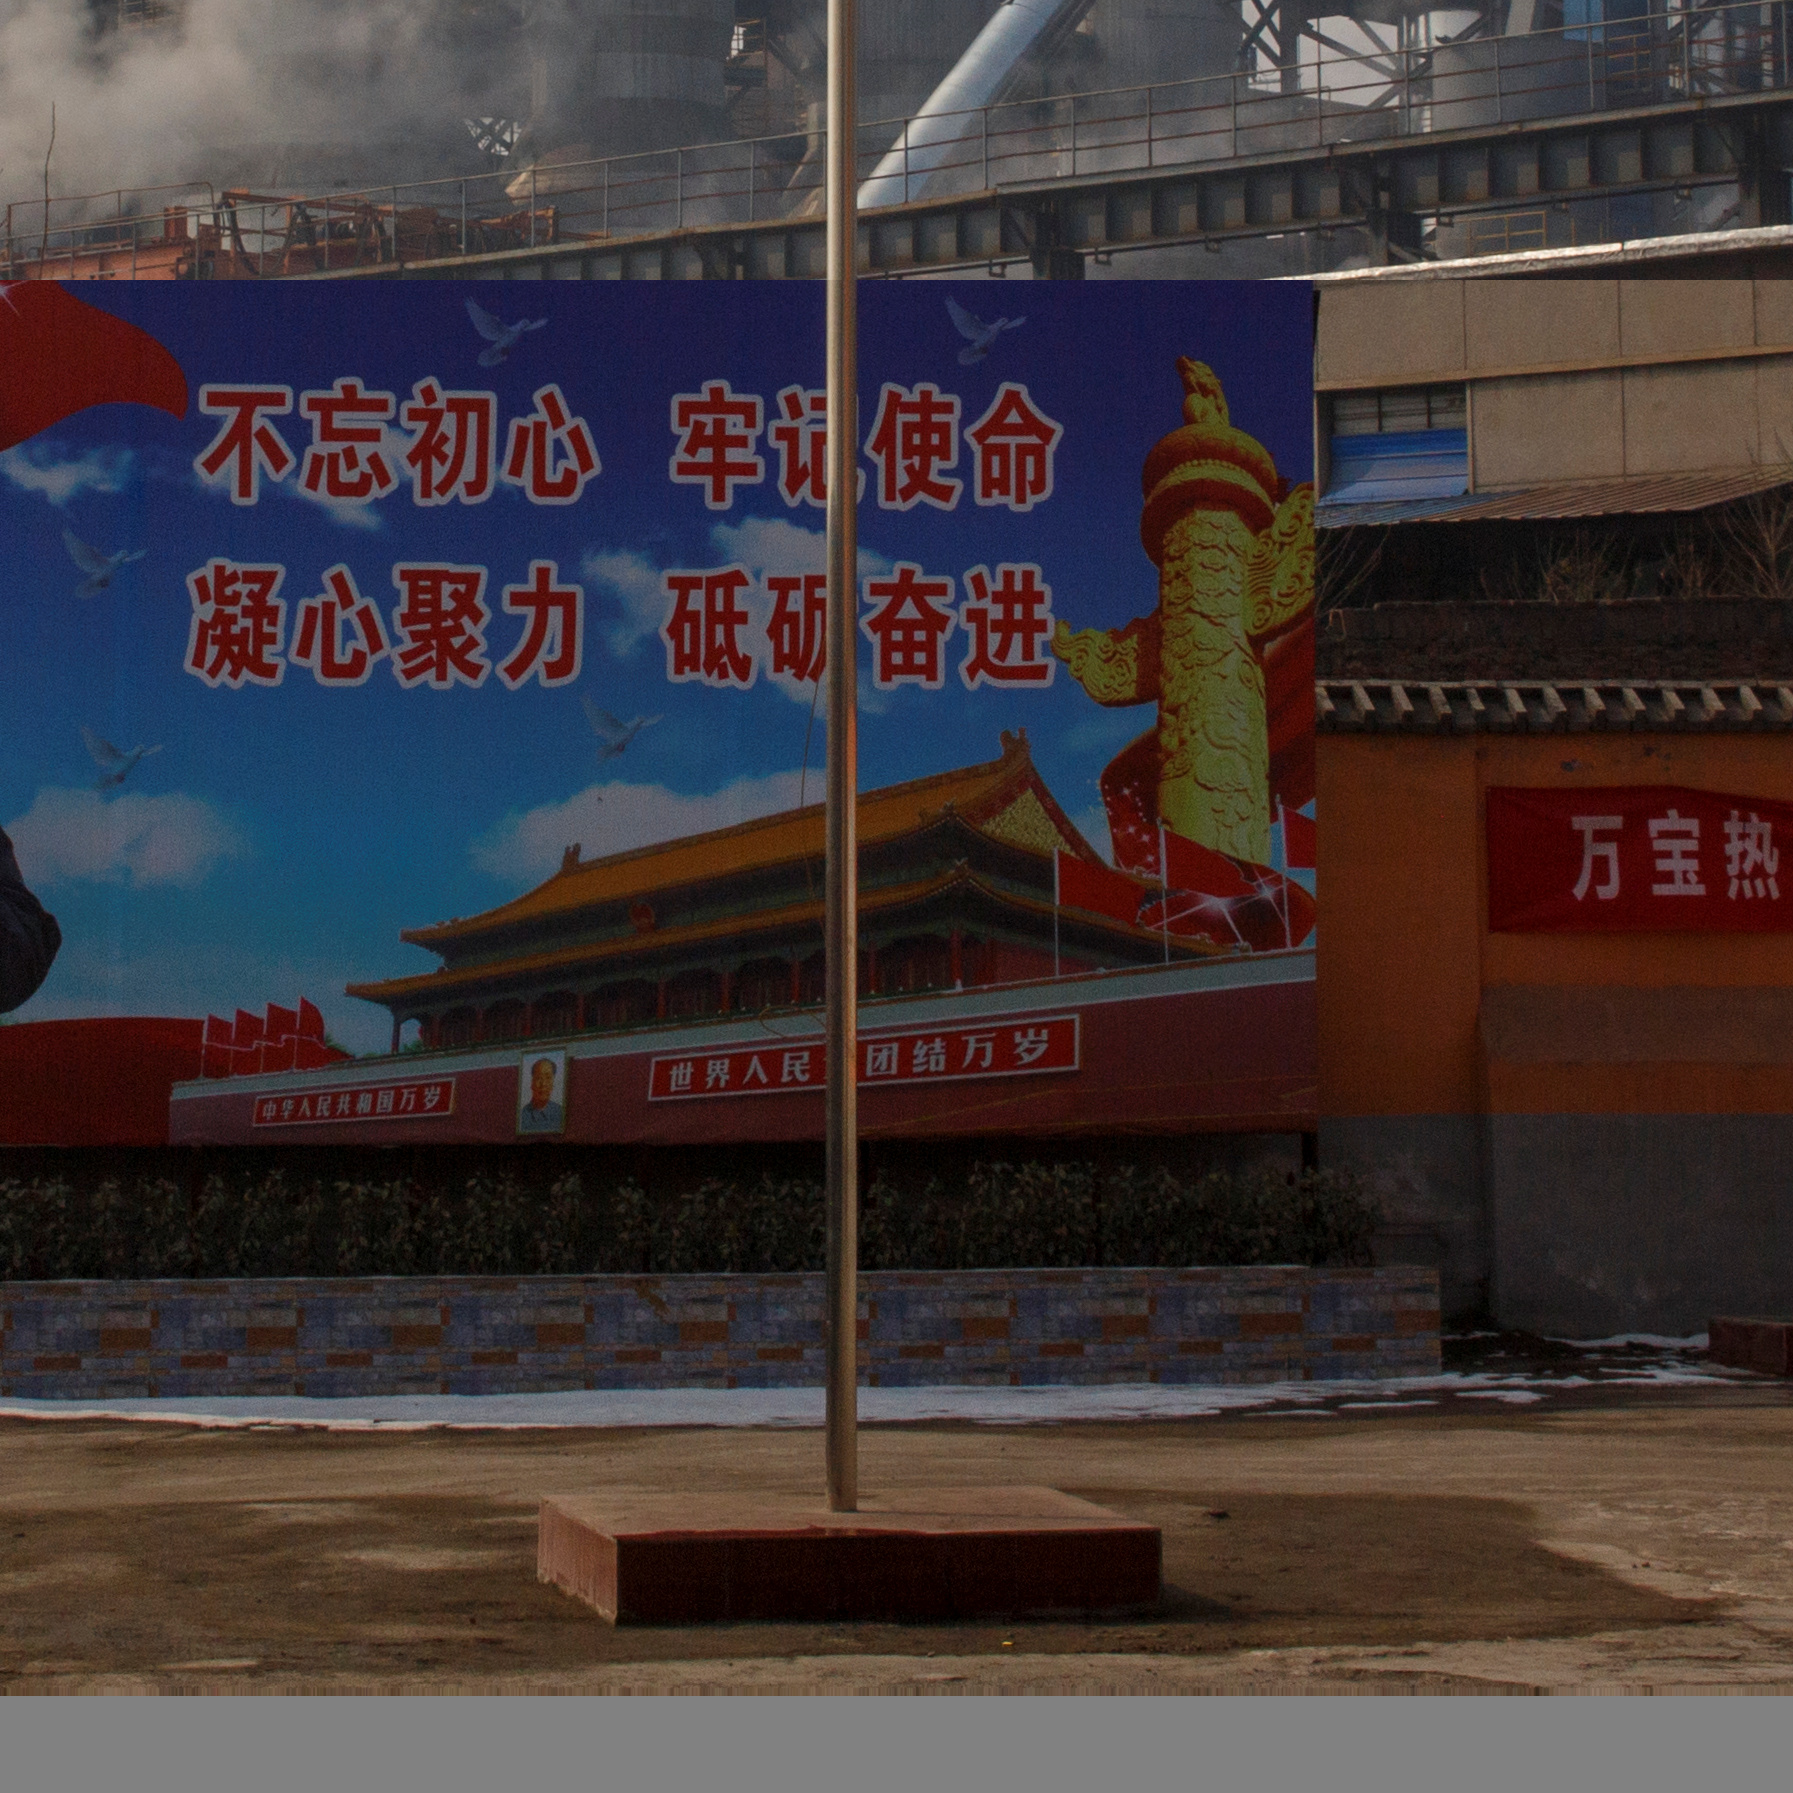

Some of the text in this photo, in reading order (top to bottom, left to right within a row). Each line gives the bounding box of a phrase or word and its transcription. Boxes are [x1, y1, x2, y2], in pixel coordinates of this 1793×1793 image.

[193, 376, 1064, 512] 不忘初心 牢记使命
[183, 557, 1056, 690] 凝心聚力 砥砺奋进
[262, 1085, 441, 1121] 中华人民共和国万岁
[668, 1027, 1050, 1093] 世界人民团结万岁
